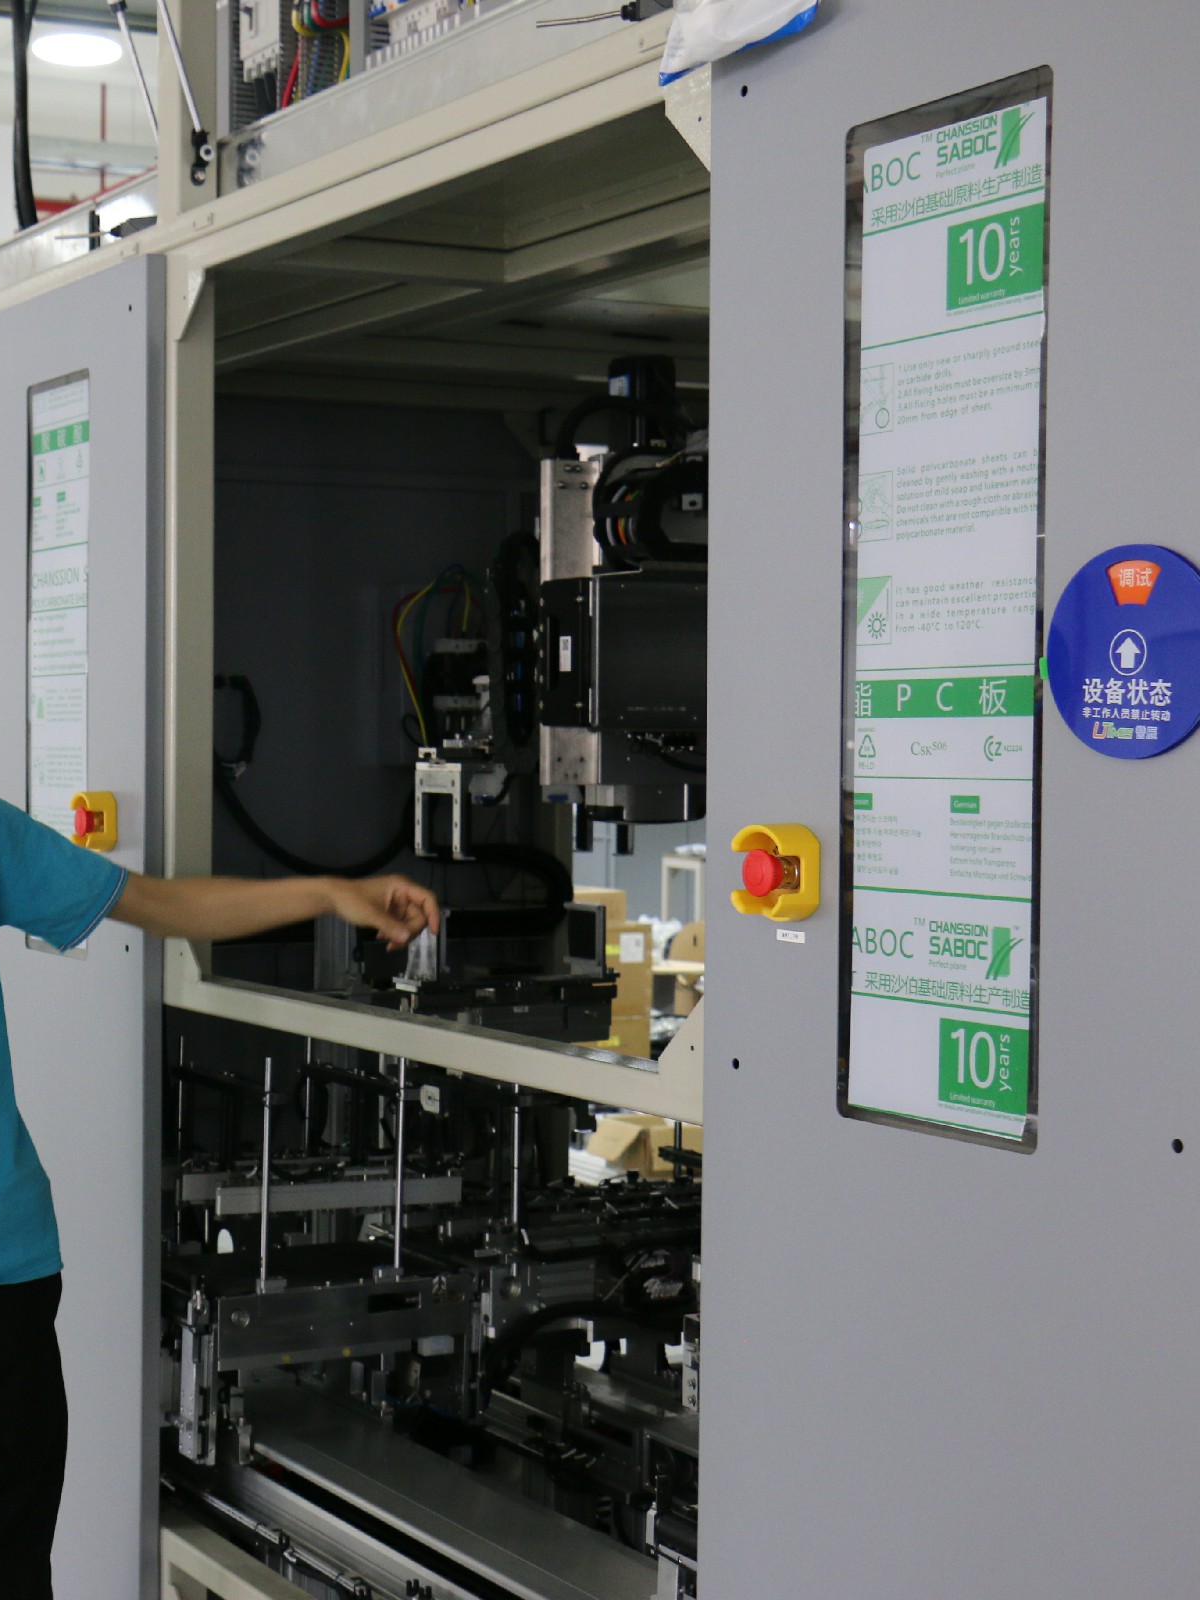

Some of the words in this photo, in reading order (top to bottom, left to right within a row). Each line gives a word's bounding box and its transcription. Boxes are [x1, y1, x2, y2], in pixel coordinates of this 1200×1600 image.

[936, 114, 997, 144] CHANSSION
[936, 131, 997, 167] SABOC
[871, 164, 1042, 226] 采用沙伯基础原料生产制造
[959, 222, 1006, 285] 10
[1009, 216, 1023, 277] years
[919, 361, 934, 370] only
[963, 349, 991, 362] sharply
[992, 345, 1020, 357] ground
[906, 374, 931, 384] carbide
[934, 382, 952, 391] holes
[954, 379, 971, 387] must
[973, 377, 981, 386] be
[983, 372, 1012, 383] oversize
[1014, 369, 1022, 379] by
[915, 398, 935, 409] fixing
[937, 395, 956, 404] holes
[958, 393, 977, 401] must
[979, 390, 988, 398] be
[996, 383, 1032, 393] minimum
[920, 412, 937, 421] from
[940, 408, 957, 419] edge
[961, 405, 968, 414] of
[896, 466, 915, 475] Solid
[921, 458, 976, 473] polycarbonate
[981, 454, 1008, 464] sheets
[1013, 450, 1026, 459] can
[897, 478, 922, 488] cleaned
[925, 477, 933, 486] by
[936, 473, 957, 485] gently
[960, 468, 988, 480] washing
[991, 466, 1007, 475] with
[896, 491, 923, 501] solution
[926, 489, 932, 497] of
[934, 486, 949, 496] mild
[951, 485, 967, 494] soap
[969, 483, 982, 492] and
[984, 479, 1018, 490] lukewarm
[896, 516, 929, 526] chemicals
[930, 513, 944, 522] that
[958, 511, 969, 519] not
[971, 506, 1011, 519] compatible
[1012, 504, 1028, 513] with
[897, 505, 906, 514] Do
[907, 504, 919, 512] not
[920, 501, 938, 511] clean
[939, 499, 954, 509] with
[961, 497, 981, 507] rough
[983, 494, 1000, 503] cloth
[896, 528, 944, 541] polycarbonate
[906, 586, 919, 594] has
[924, 583, 944, 595] good
[949, 581, 984, 590] weather
[1119, 568, 1153, 587] 调试
[895, 600, 909, 608] can
[912, 596, 948, 607] maintain
[951, 594, 991, 604] excellent
[895, 612, 903, 620] in
[920, 609, 940, 618] wide
[947, 606, 1006, 618] temperature
[895, 624, 914, 633] from
[944, 622, 953, 630] to
[897, 684, 911, 711] P
[936, 682, 953, 711] C
[979, 679, 1007, 714] 板
[1082, 678, 1172, 706] 设备状态
[1082, 706, 1171, 721] 非工作人员禁止转动
[953, 800, 977, 809] German
[929, 920, 988, 937] CHANSSION
[929, 936, 988, 960] SABOC
[951, 1028, 996, 1089] 10
[999, 1034, 1013, 1092] years
